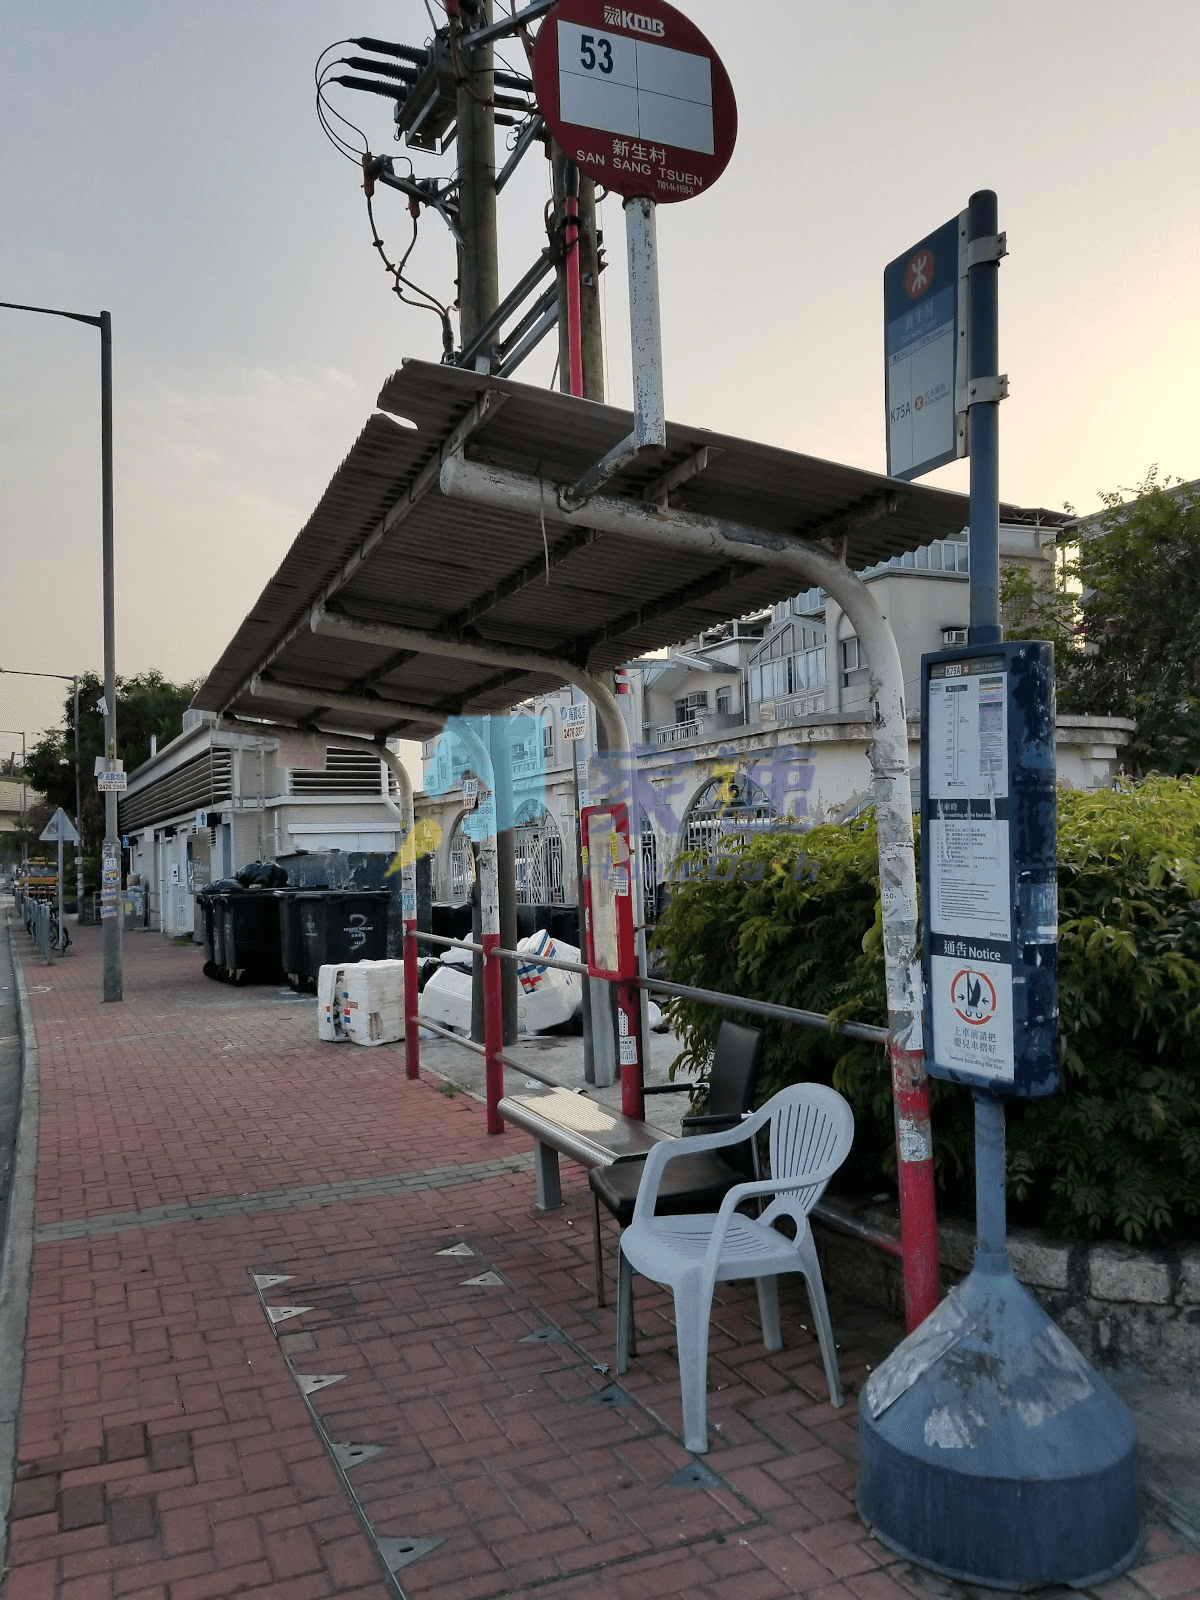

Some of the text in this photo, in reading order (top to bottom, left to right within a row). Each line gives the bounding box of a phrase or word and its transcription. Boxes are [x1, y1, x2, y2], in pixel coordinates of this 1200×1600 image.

[621, 10, 665, 37] KMB
[580, 35, 614, 74] 53
[612, 138, 667, 165] 新生村
[576, 149, 703, 187] SAN SANG TSUEN
[890, 401, 911, 424] K75A
[946, 666, 961, 675] K75A
[944, 940, 1001, 961] 通告 Notice
[953, 1026, 996, 1042] 上車前請把
[949, 1054, 965, 1062] before
[965, 1056, 985, 1067] boarding
